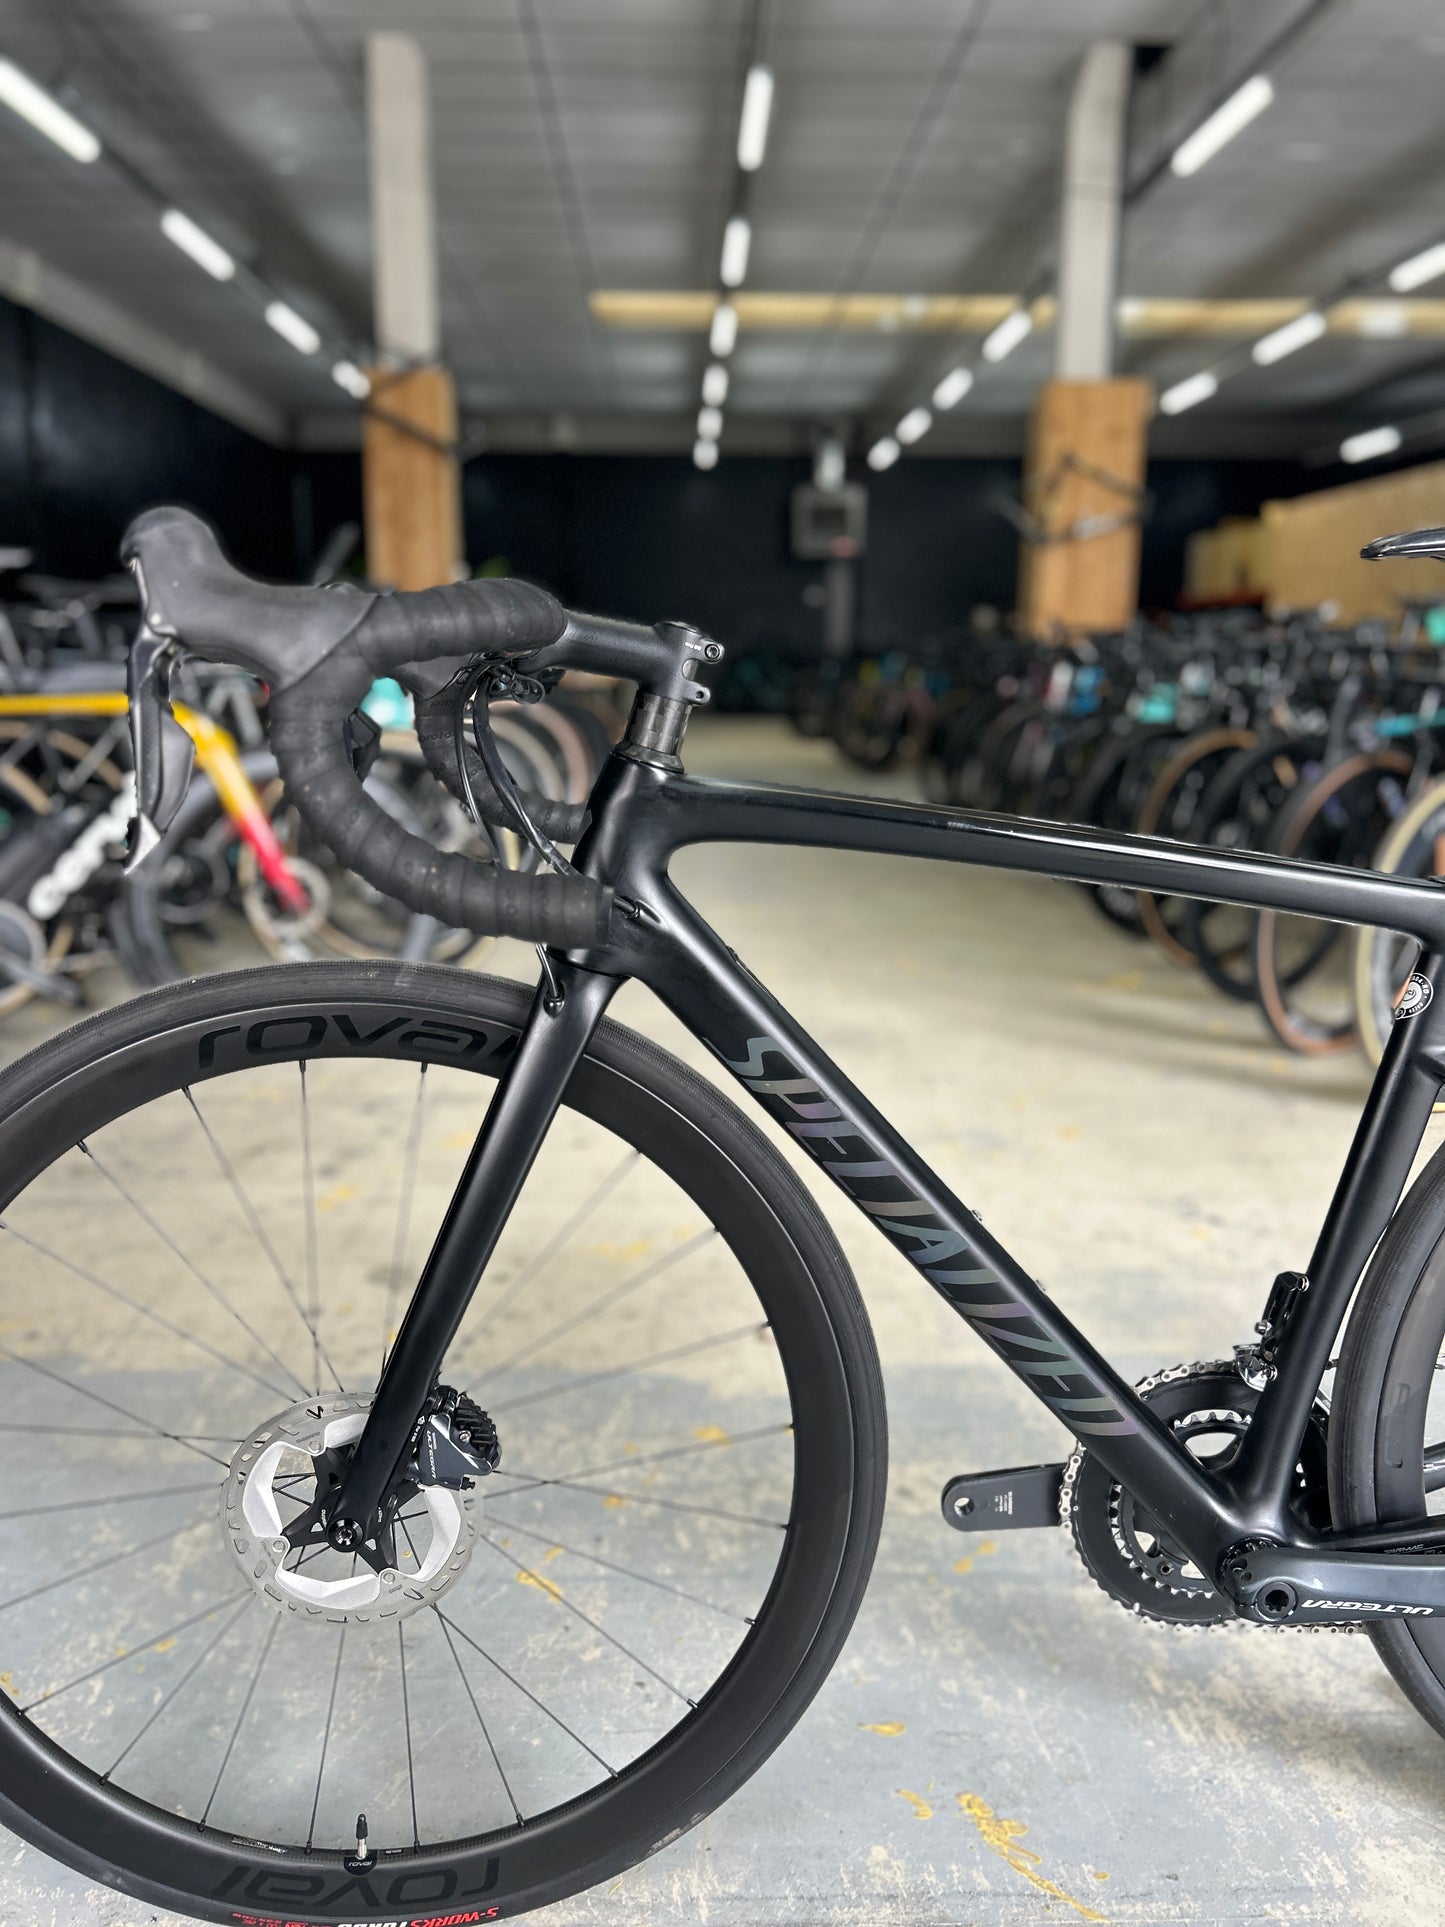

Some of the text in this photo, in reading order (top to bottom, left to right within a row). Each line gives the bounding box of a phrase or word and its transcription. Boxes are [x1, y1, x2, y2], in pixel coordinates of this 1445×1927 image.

[701, 1036, 1140, 1436] SPECIALIZED
[1301, 1599, 1434, 1615] ULTEGRA
[212, 1857, 500, 1908] roval
[410, 1906, 500, 1927] S-WORKS
